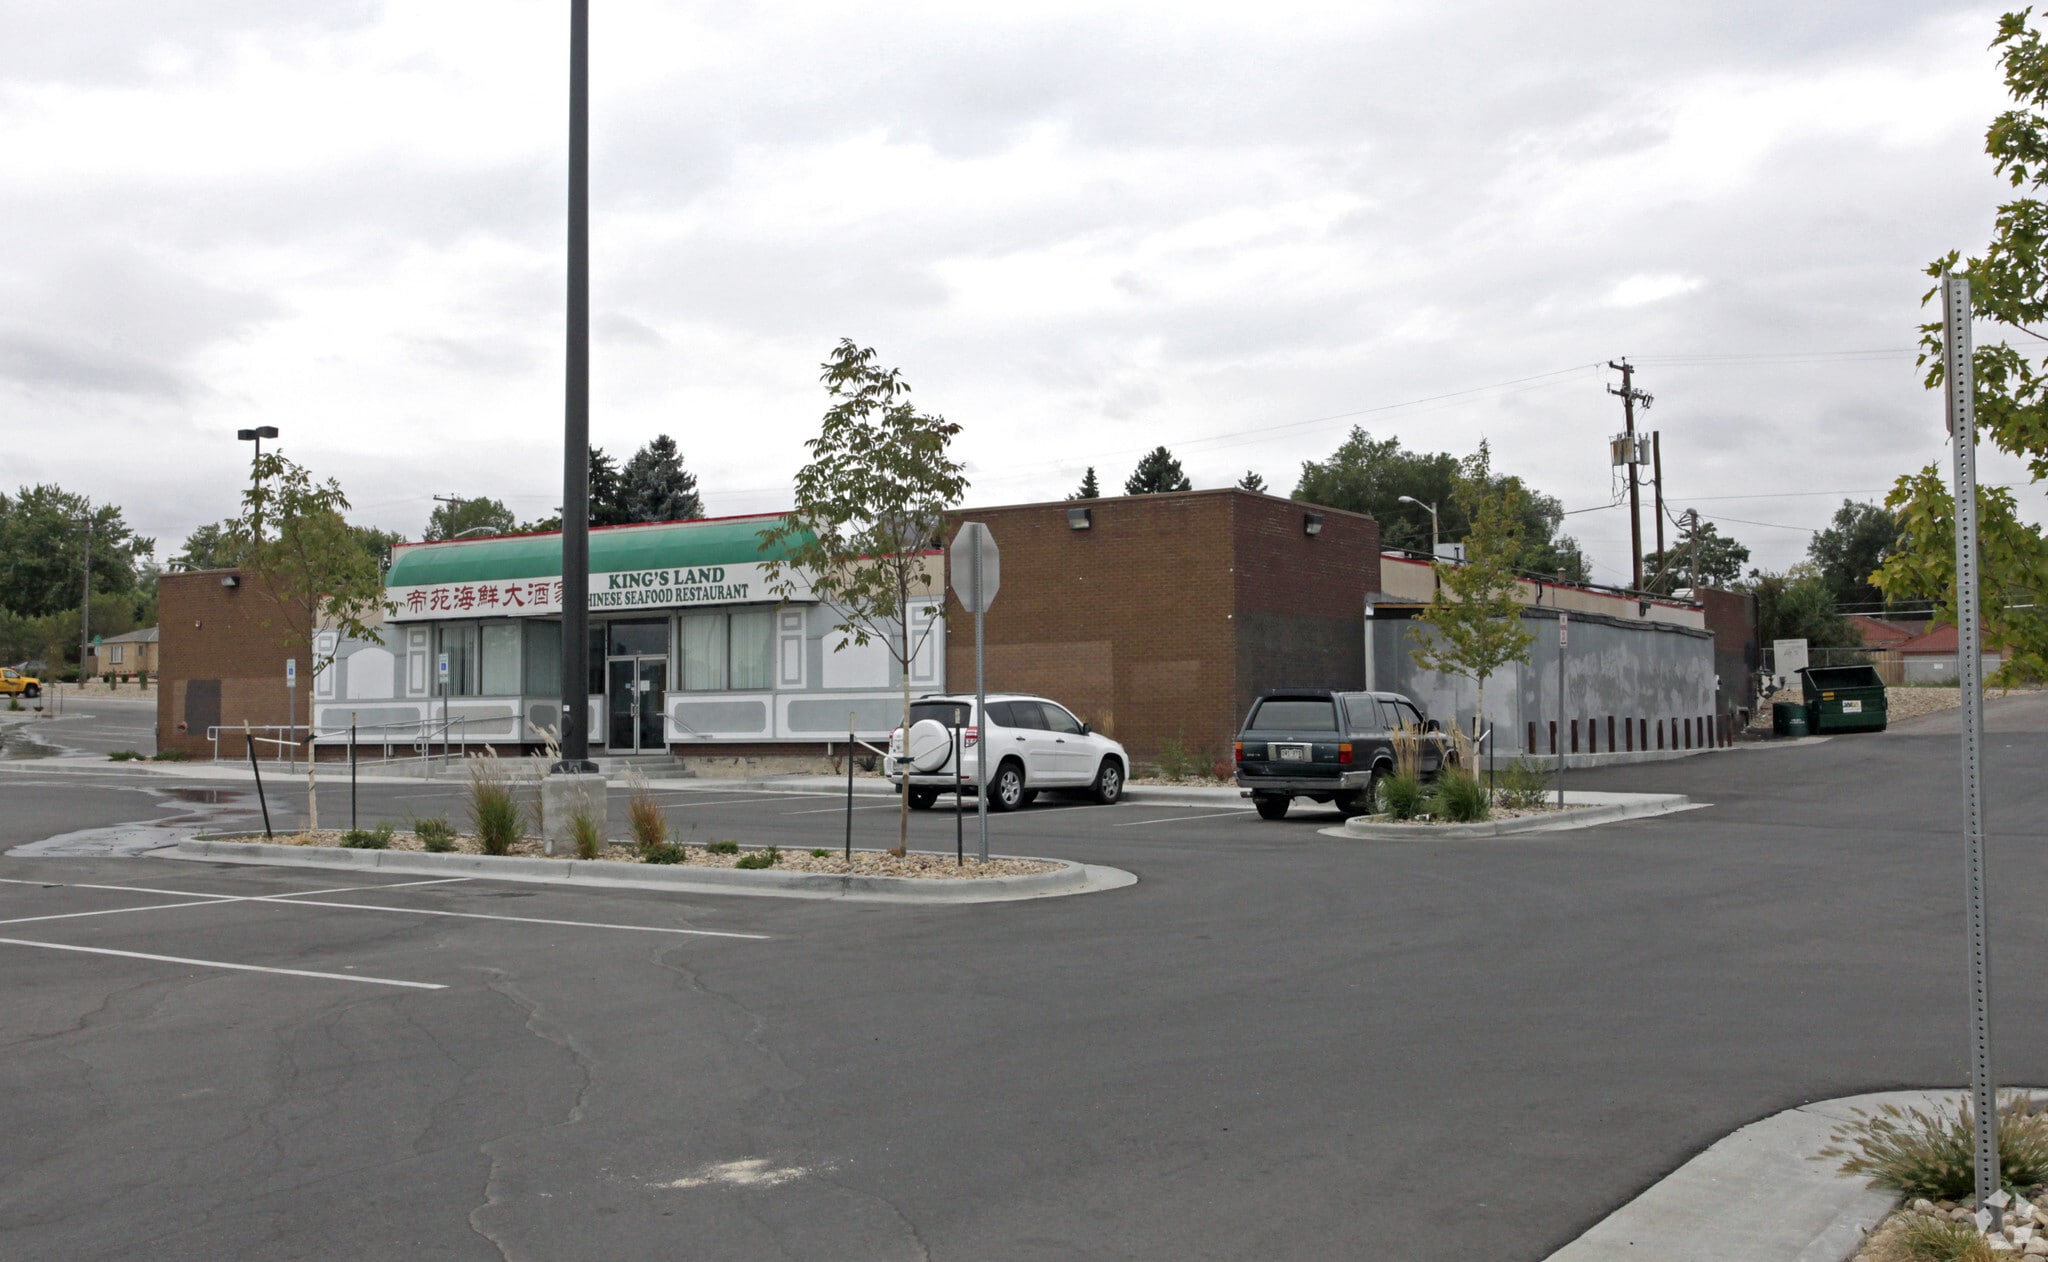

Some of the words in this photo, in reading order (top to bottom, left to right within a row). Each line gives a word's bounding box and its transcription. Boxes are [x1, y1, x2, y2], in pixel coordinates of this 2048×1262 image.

[609, 571, 669, 590] KING'S
[674, 567, 725, 585] LAND
[588, 591, 623, 607] HINESE
[625, 588, 673, 606] SEAFOOD
[675, 584, 749, 602] RESTAURANT
